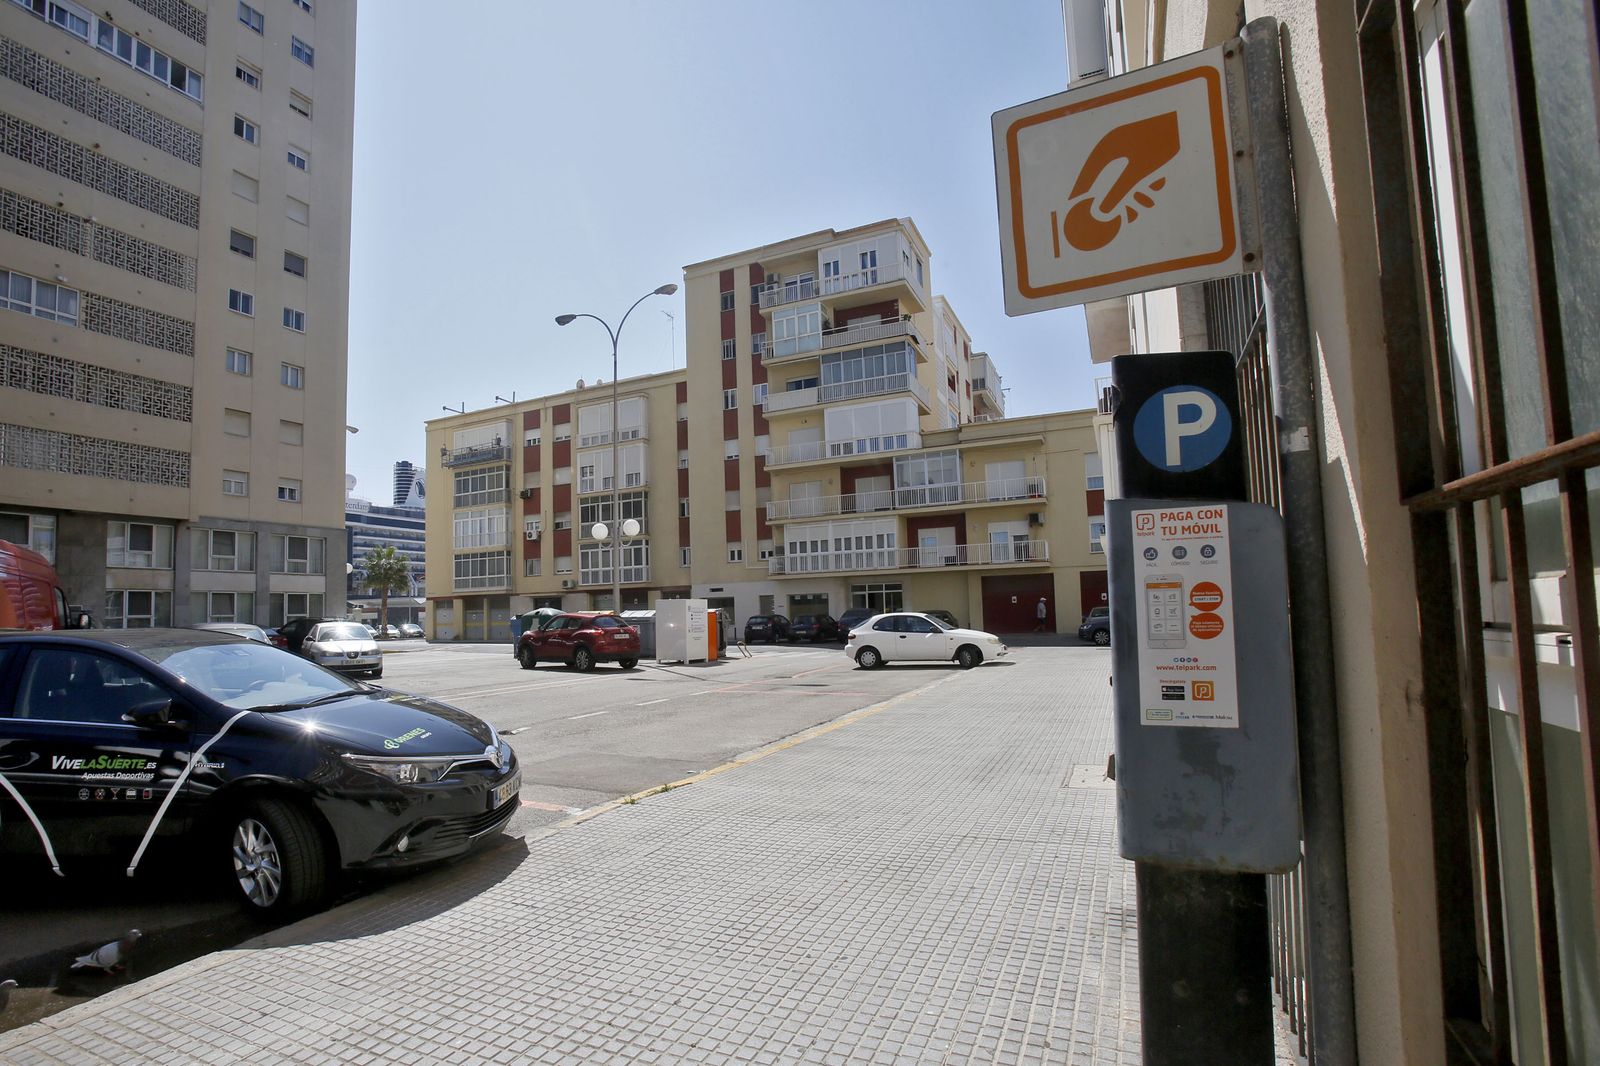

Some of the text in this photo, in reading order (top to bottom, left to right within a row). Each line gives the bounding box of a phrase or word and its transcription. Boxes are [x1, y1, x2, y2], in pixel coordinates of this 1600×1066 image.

[1162, 390, 1217, 467] P
[1160, 509, 1223, 522] PAGA CON
[1161, 522, 1222, 535] TU MÓVIL
[81, 772, 115, 780] Apuestas
